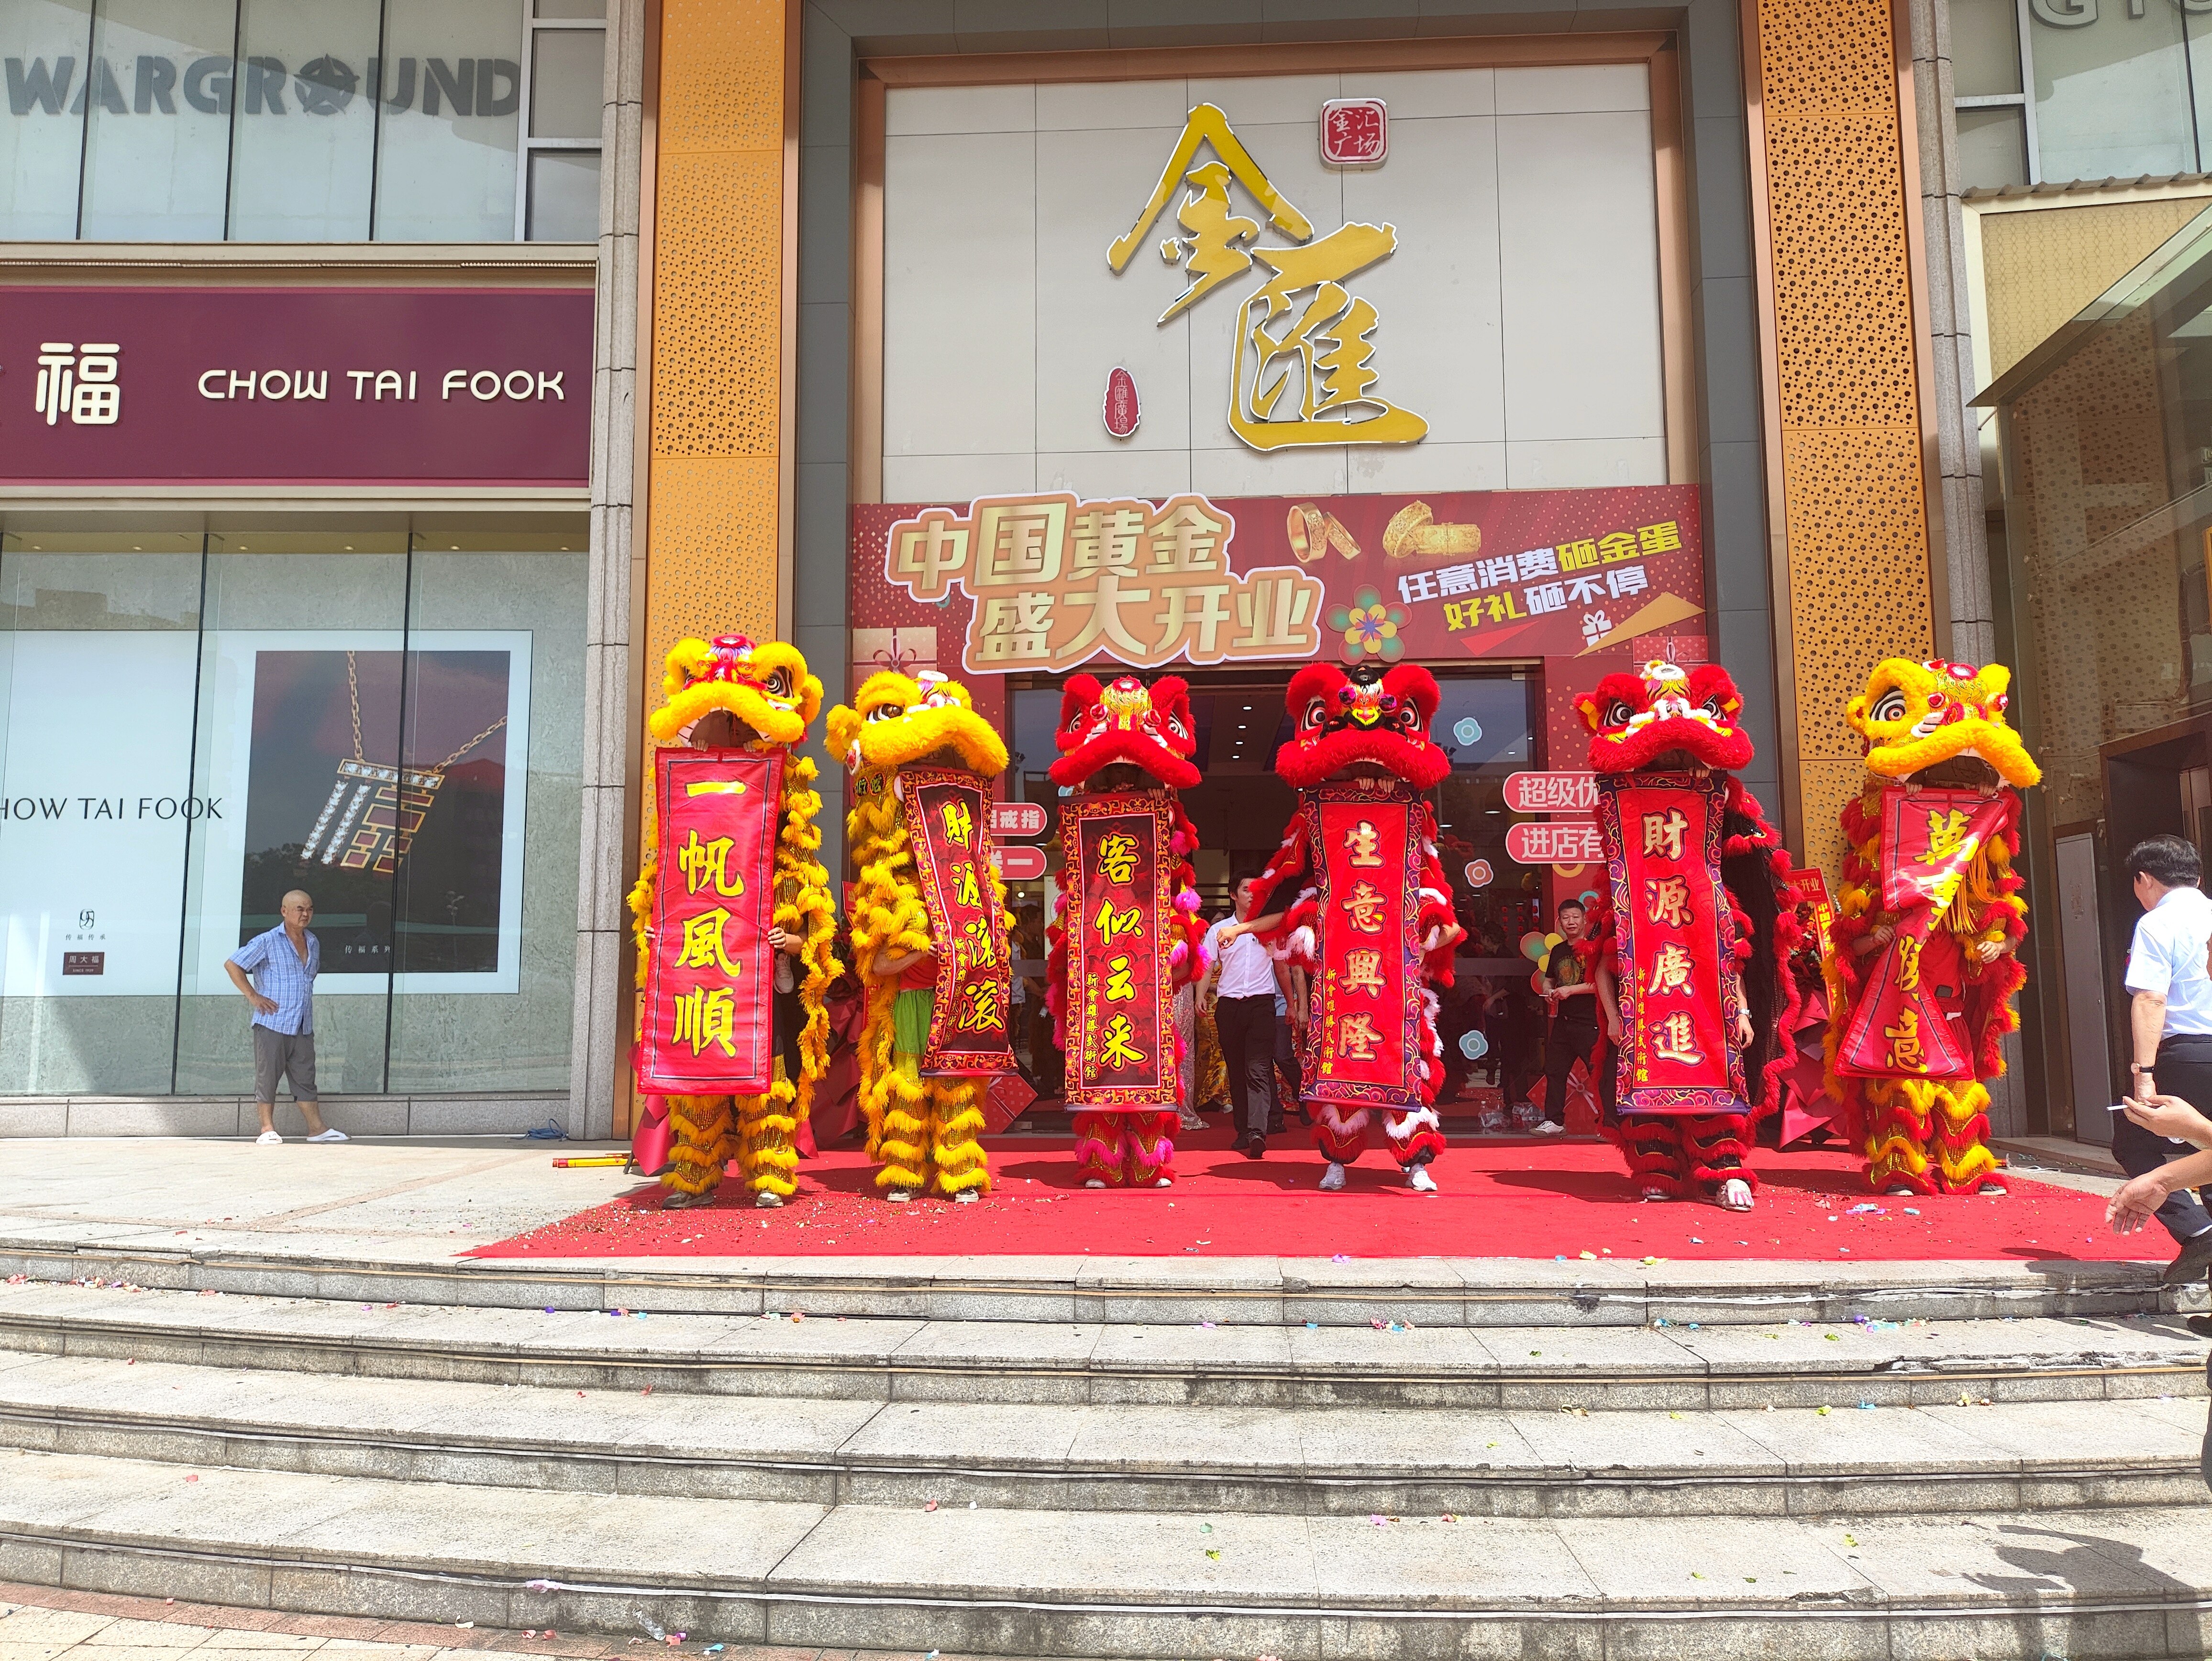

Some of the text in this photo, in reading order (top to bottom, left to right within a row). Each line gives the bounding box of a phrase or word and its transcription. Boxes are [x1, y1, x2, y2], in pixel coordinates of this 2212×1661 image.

[4, 53, 521, 117] WARGROUND
[1334, 132, 1380, 156] 广场
[35, 343, 121, 426] 福
[198, 369, 565, 401] CHOW TAI FOOK
[897, 502, 1222, 590] 中国黄金
[1397, 520, 1682, 604] 任意消费砸金蛋
[975, 576, 1311, 661] 盛大开业
[1443, 565, 1648, 632] 好礼砸不停
[77, 798, 123, 819] TAI
[138, 797, 223, 819] FOOK
[1518, 776, 1601, 808] 超级优
[990, 809, 1040, 829] 戒指
[1521, 827, 1604, 858] 进店有
[672, 780, 747, 1058] 一帆風順
[68, 955, 100, 963] 周大福
